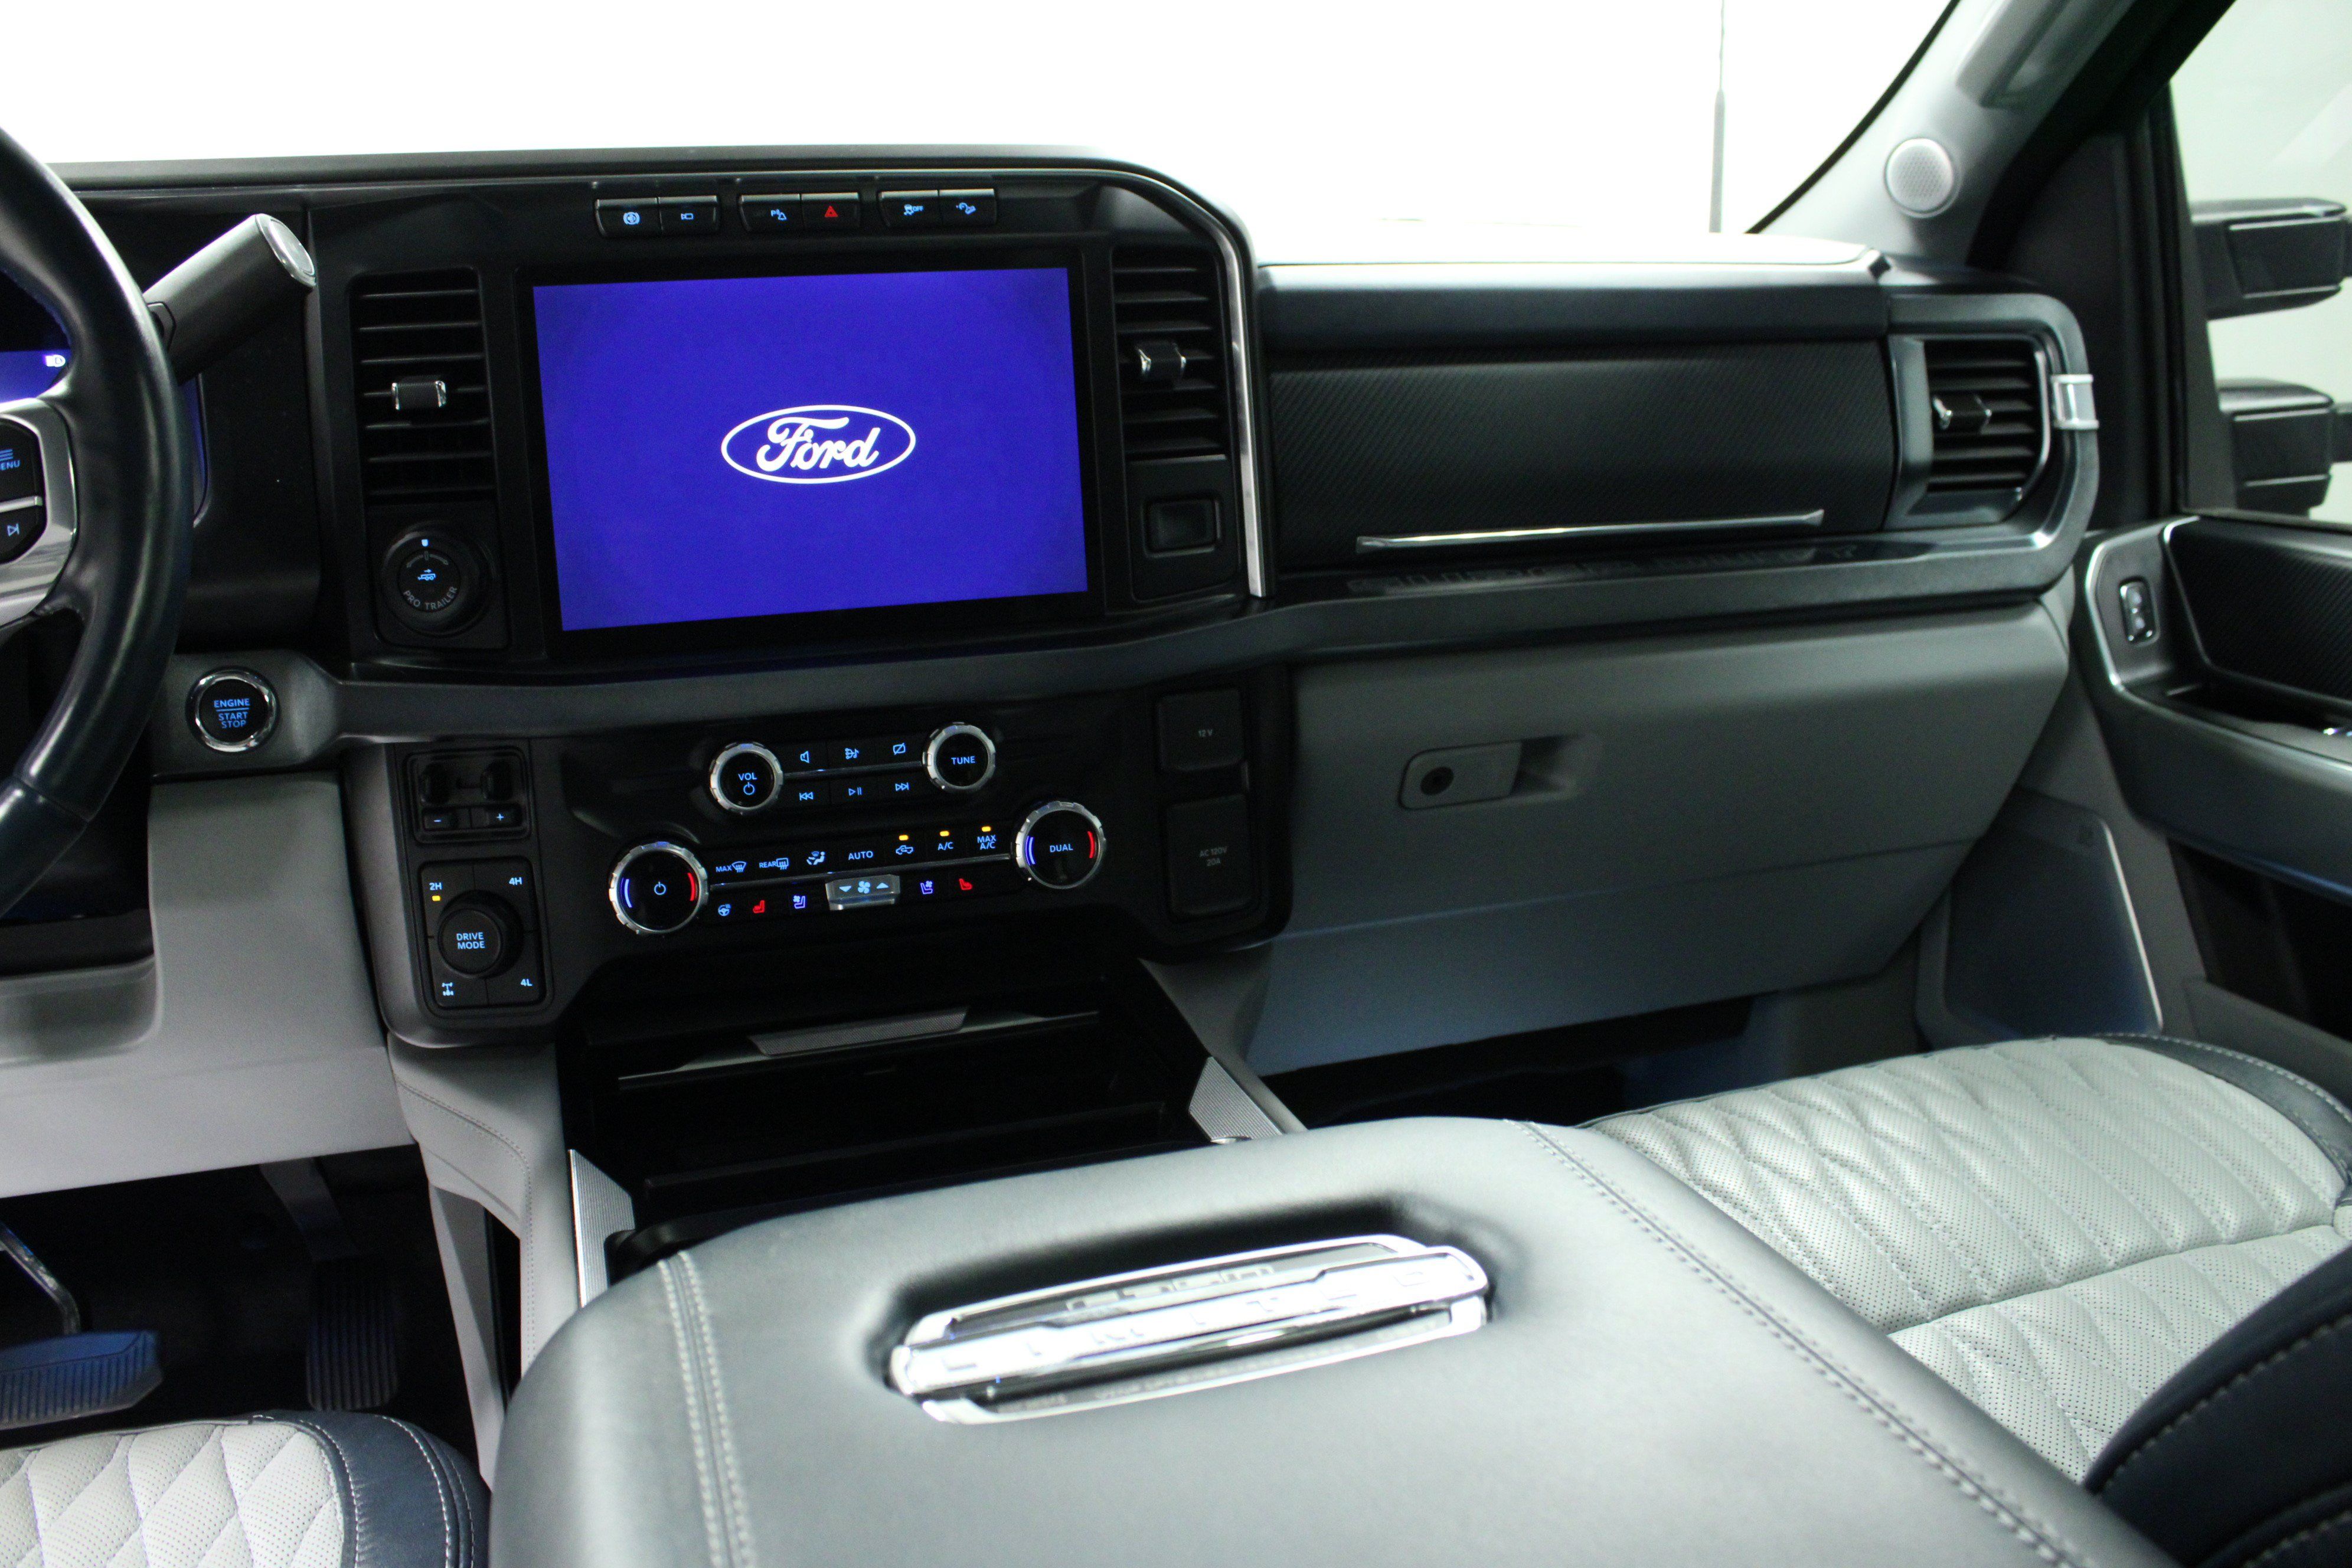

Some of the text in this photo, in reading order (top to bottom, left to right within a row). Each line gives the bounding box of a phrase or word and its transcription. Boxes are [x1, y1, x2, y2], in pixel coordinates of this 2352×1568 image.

[756, 416, 881, 472] Ford
[0, 459, 21, 471] ENU
[403, 586, 458, 609] PRO TRAILER
[214, 698, 250, 707] ENGINE
[218, 712, 247, 720] START
[221, 720, 246, 729] STOP
[951, 756, 976, 765] TUNE
[738, 772, 757, 781] VOL
[977, 835, 997, 844] MAX
[937, 841, 953, 851] A/C
[979, 842, 996, 850] A/C
[1049, 843, 1073, 853] DUAL
[848, 850, 874, 860] AUTO
[716, 864, 732, 873] MAX
[759, 860, 776, 868] REAR
[508, 877, 522, 886] 4H
[429, 882, 443, 891] 2H
[456, 932, 484, 941] DRIVE
[457, 941, 485, 949] MODE
[520, 978, 533, 986] 4L
